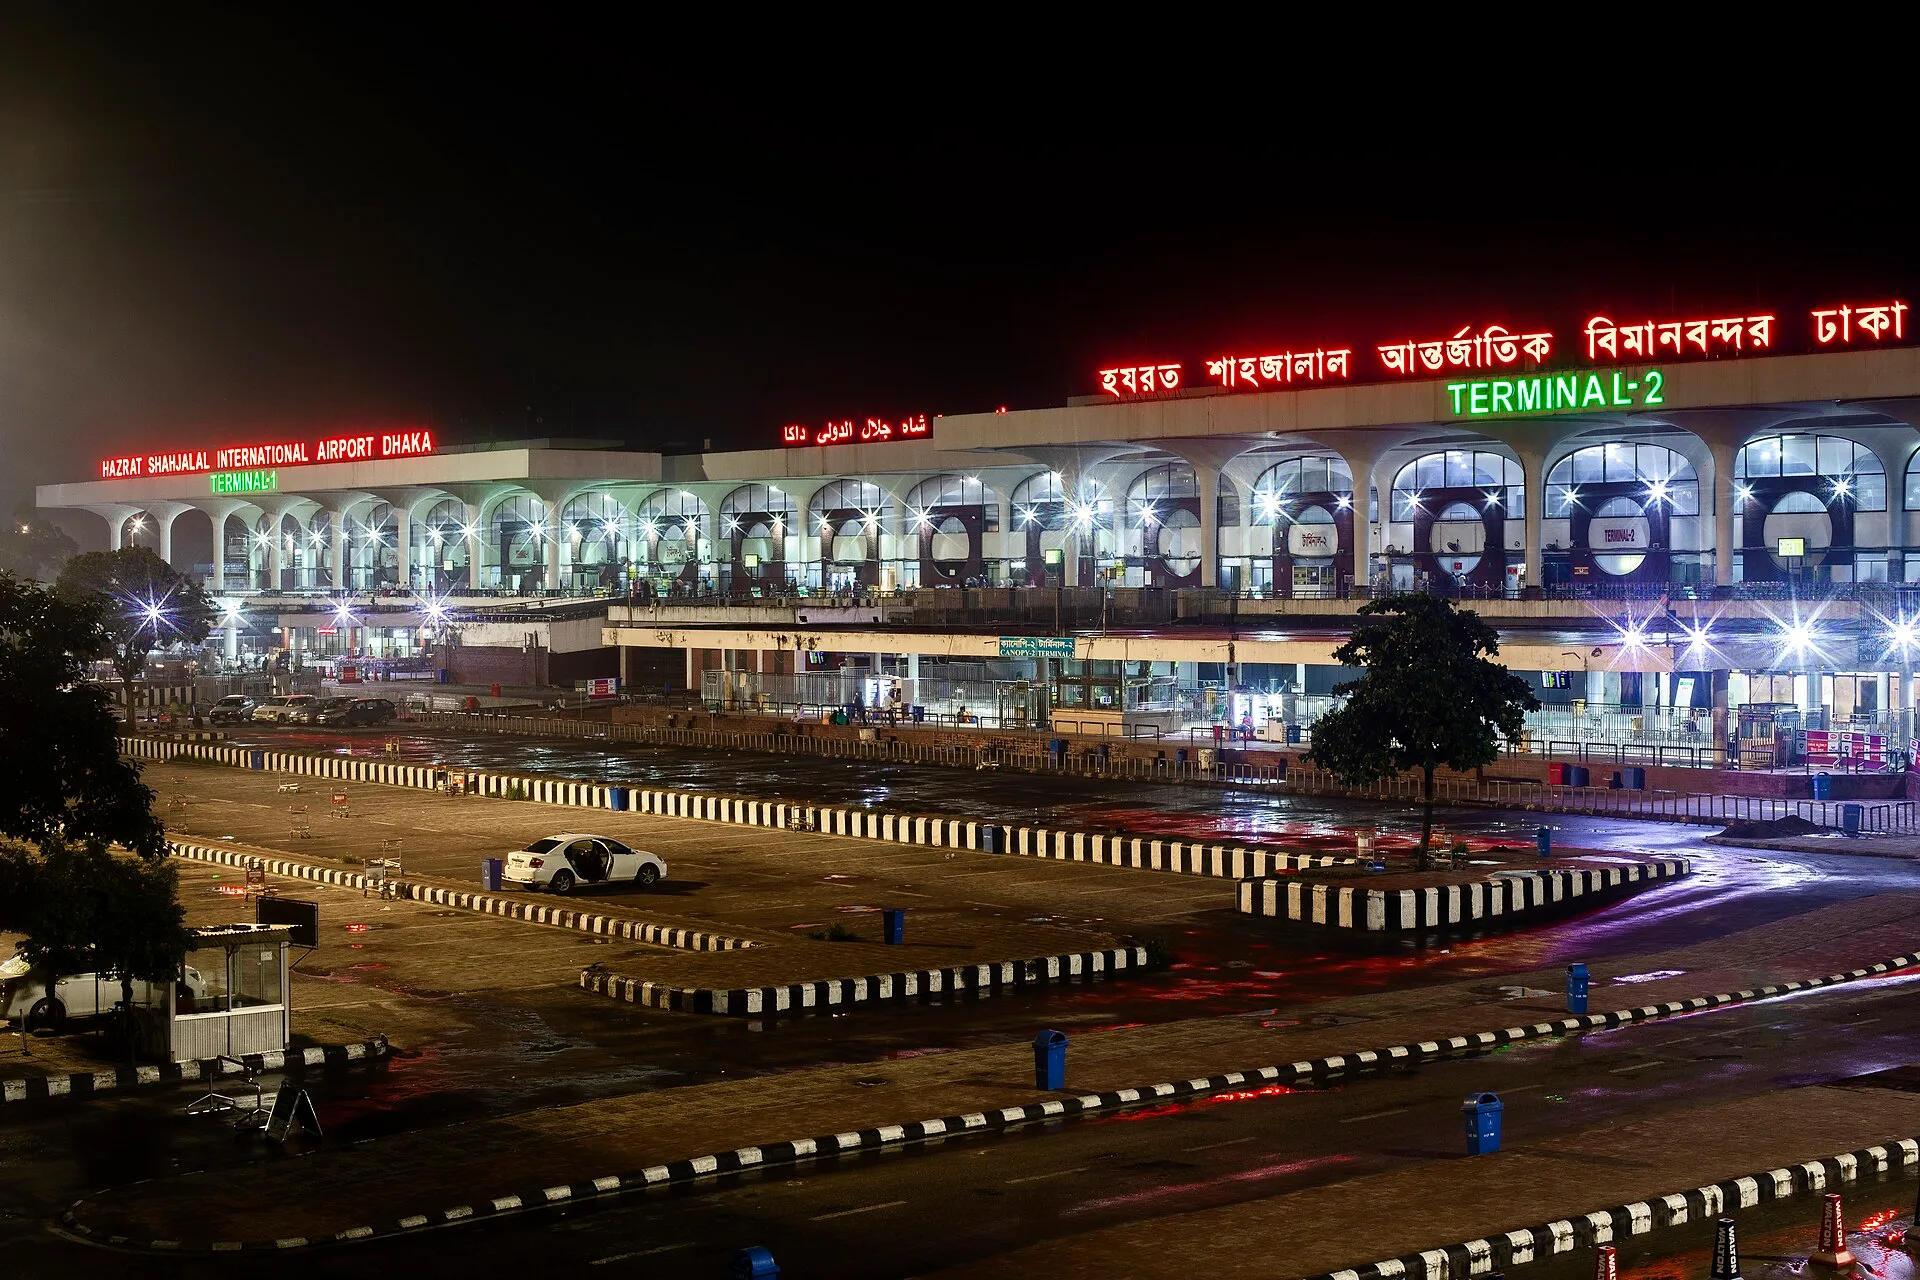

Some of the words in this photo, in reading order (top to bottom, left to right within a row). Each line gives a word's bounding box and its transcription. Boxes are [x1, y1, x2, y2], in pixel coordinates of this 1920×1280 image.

[1099, 364, 1181, 398] হযরত
[1206, 348, 1352, 388] শাহজালাল
[1377, 325, 1553, 374] আন্তর্জাতিক
[1584, 316, 1775, 359] বিমানবন্দর
[1811, 301, 1908, 343] ঢাকা
[1447, 370, 1664, 415] TERMINAL-2
[784, 425, 806, 441] داكا
[862, 418, 891, 441] جلال
[902, 414, 926, 434] شاه
[102, 457, 142, 477] HAZRAT
[148, 451, 211, 474] SHAHJALAL
[217, 442, 309, 469] INTERNATIONAL
[317, 436, 374, 461] AIRPORT
[383, 431, 432, 456] DHAKA
[210, 470, 277, 493] TERMINAL-1
[1604, 528, 1635, 543] TERMINAL-2
[1000, 649, 1036, 657] CANOPY-2
[1038, 650, 1075, 658] TERMINAL-2
[1823, 1201, 1833, 1247] WALTON
[1835, 1200, 1844, 1247] WALTON
[1597, 1254, 1606, 1280] WAL
[1716, 1226, 1726, 1274] WALTON
[1728, 1225, 1737, 1274] WALTON
